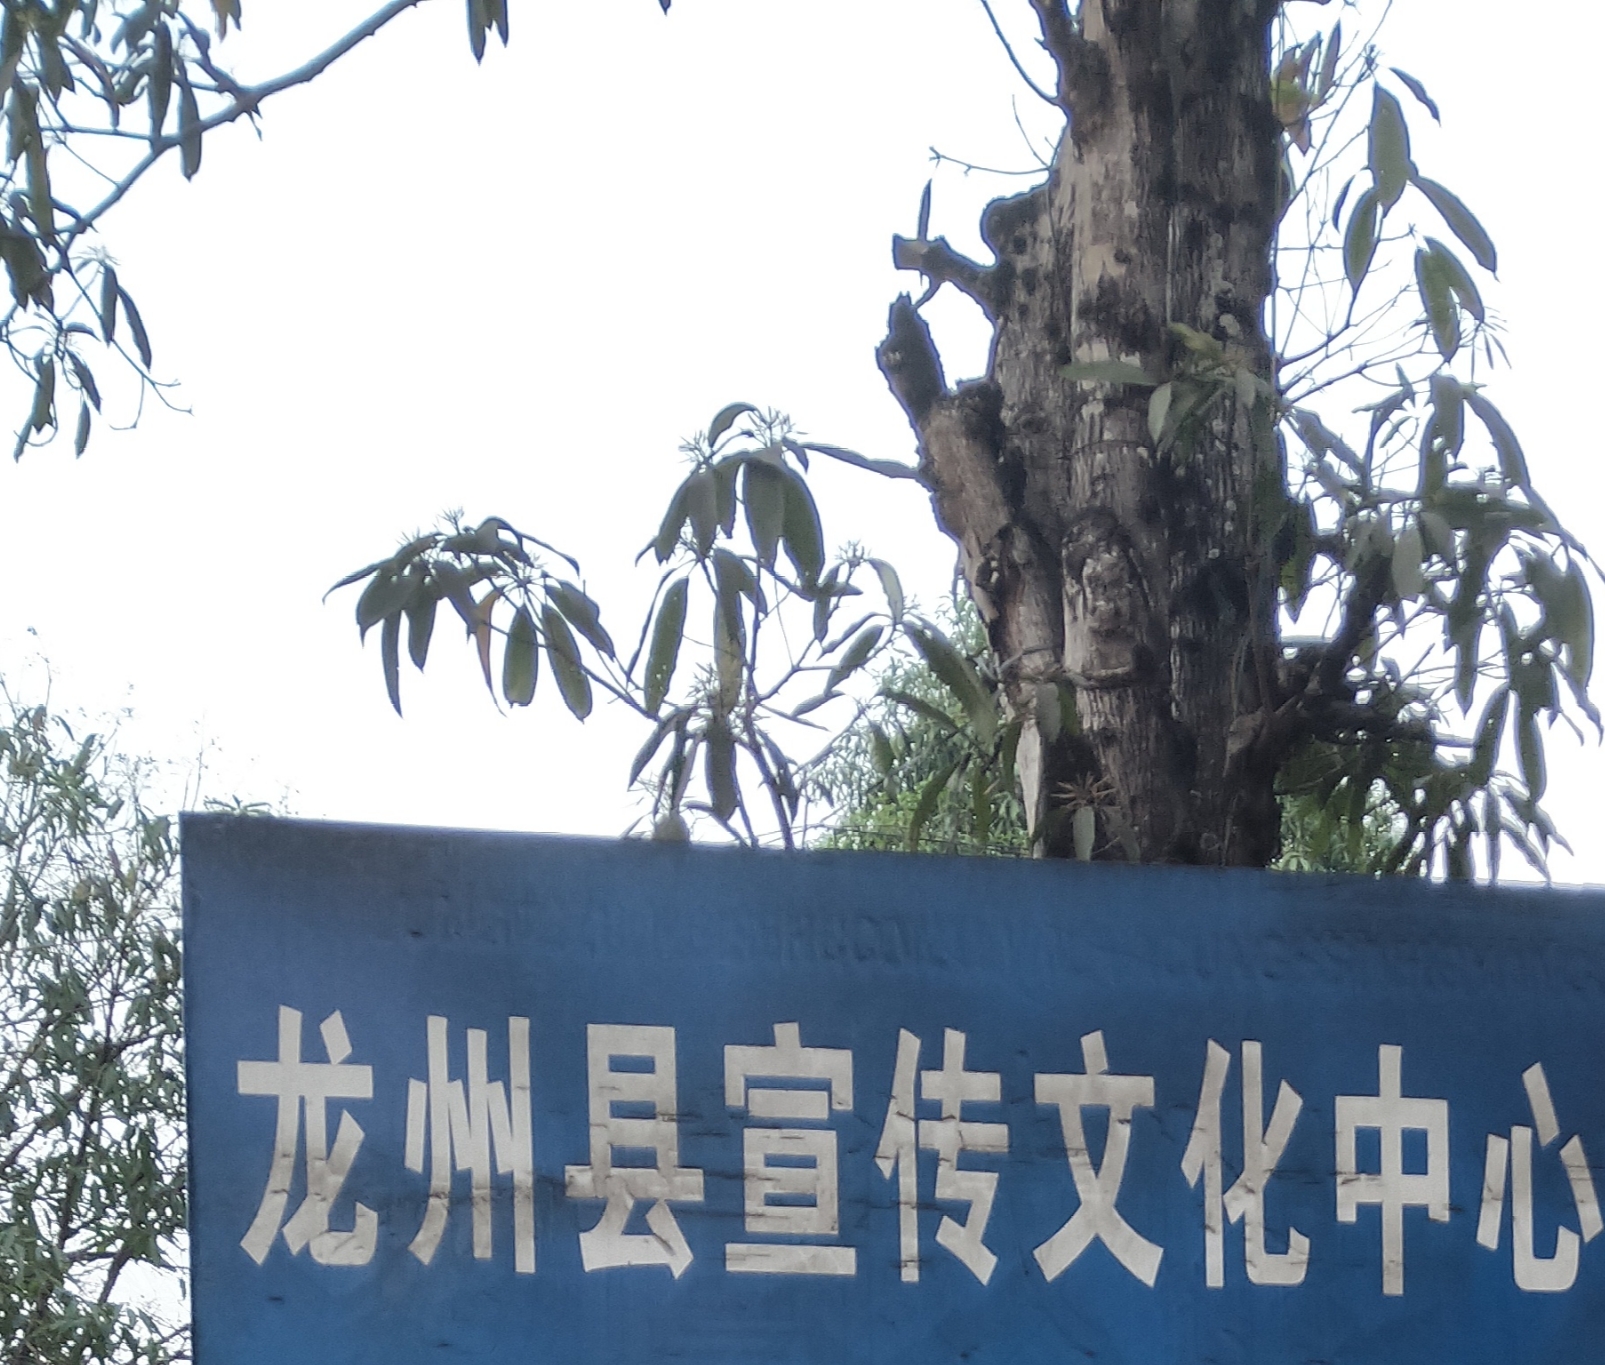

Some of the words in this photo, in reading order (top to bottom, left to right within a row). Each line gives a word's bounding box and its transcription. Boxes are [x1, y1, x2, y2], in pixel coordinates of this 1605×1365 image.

[238, 1006, 1603, 1296] 龙州县宣传文化中心
